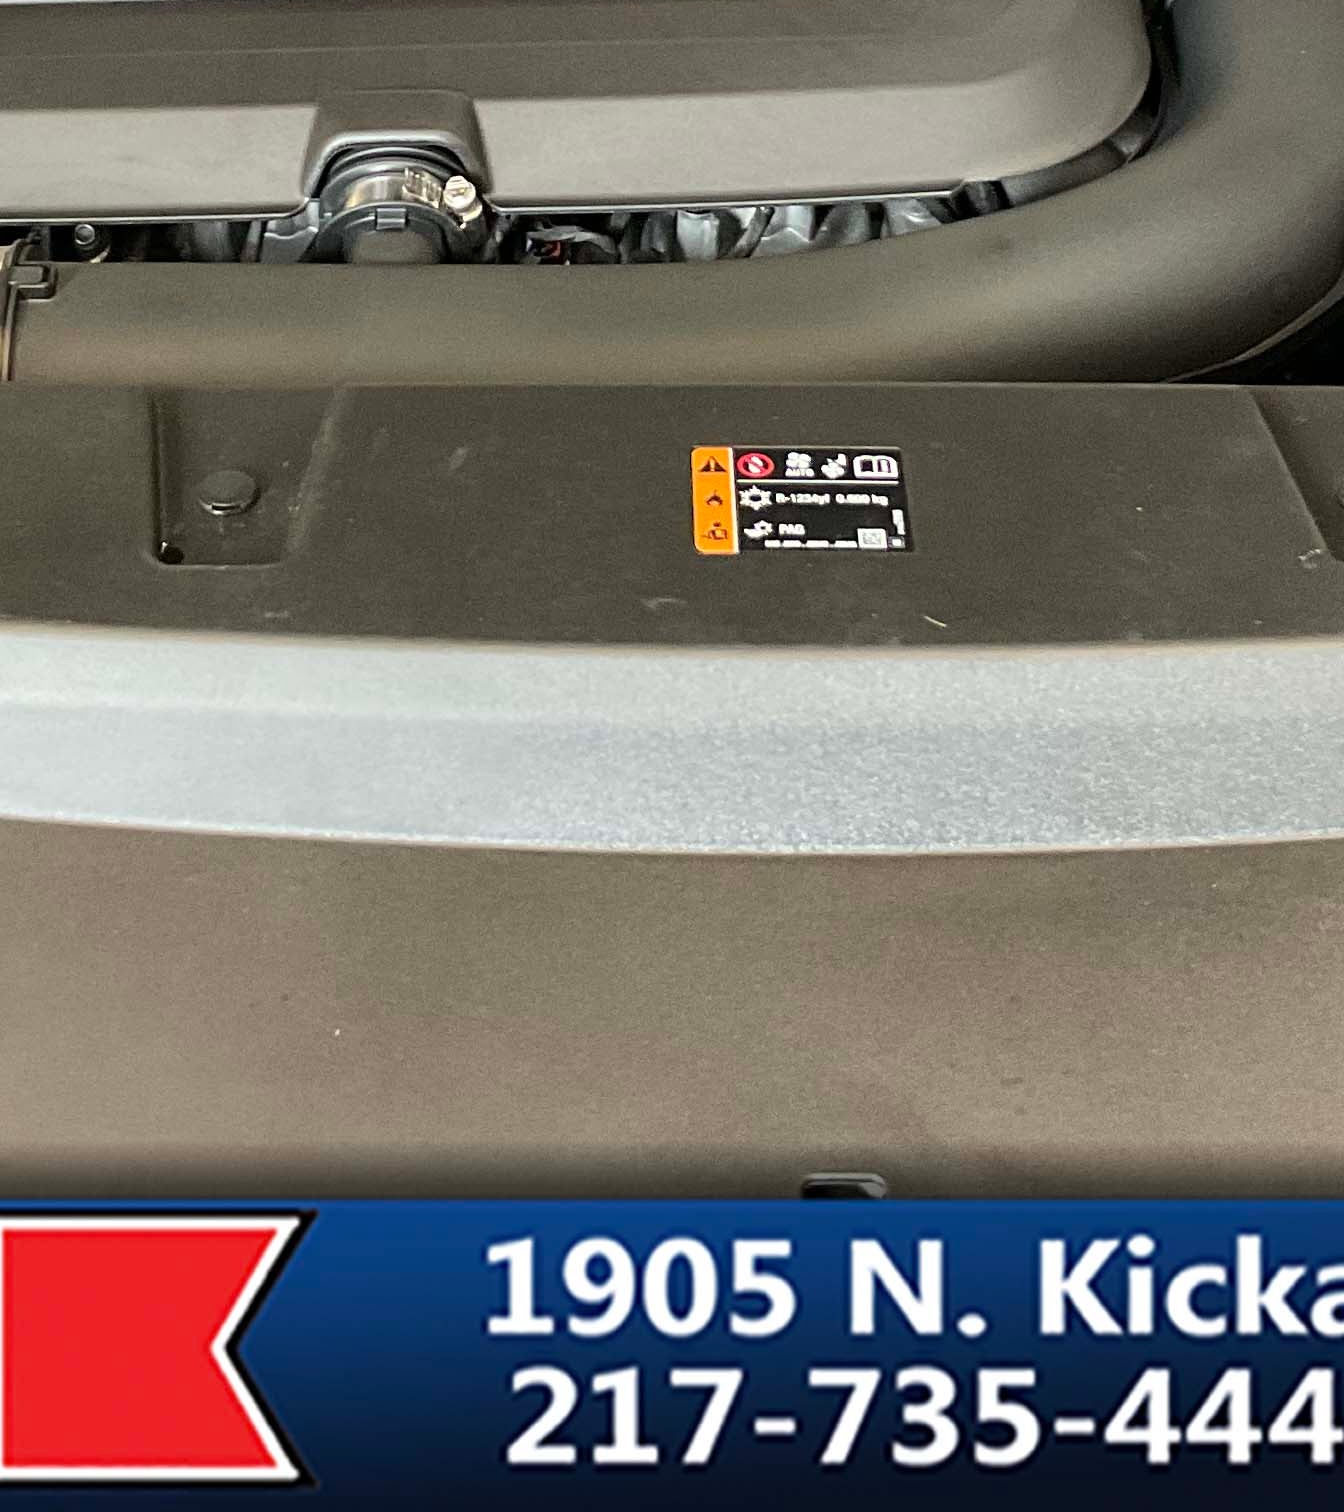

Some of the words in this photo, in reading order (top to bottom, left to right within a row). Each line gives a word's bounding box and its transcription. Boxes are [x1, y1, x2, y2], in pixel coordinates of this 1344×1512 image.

[784, 467, 815, 477] AUTO
[871, 494, 889, 507] kg
[778, 523, 806, 536] PAG
